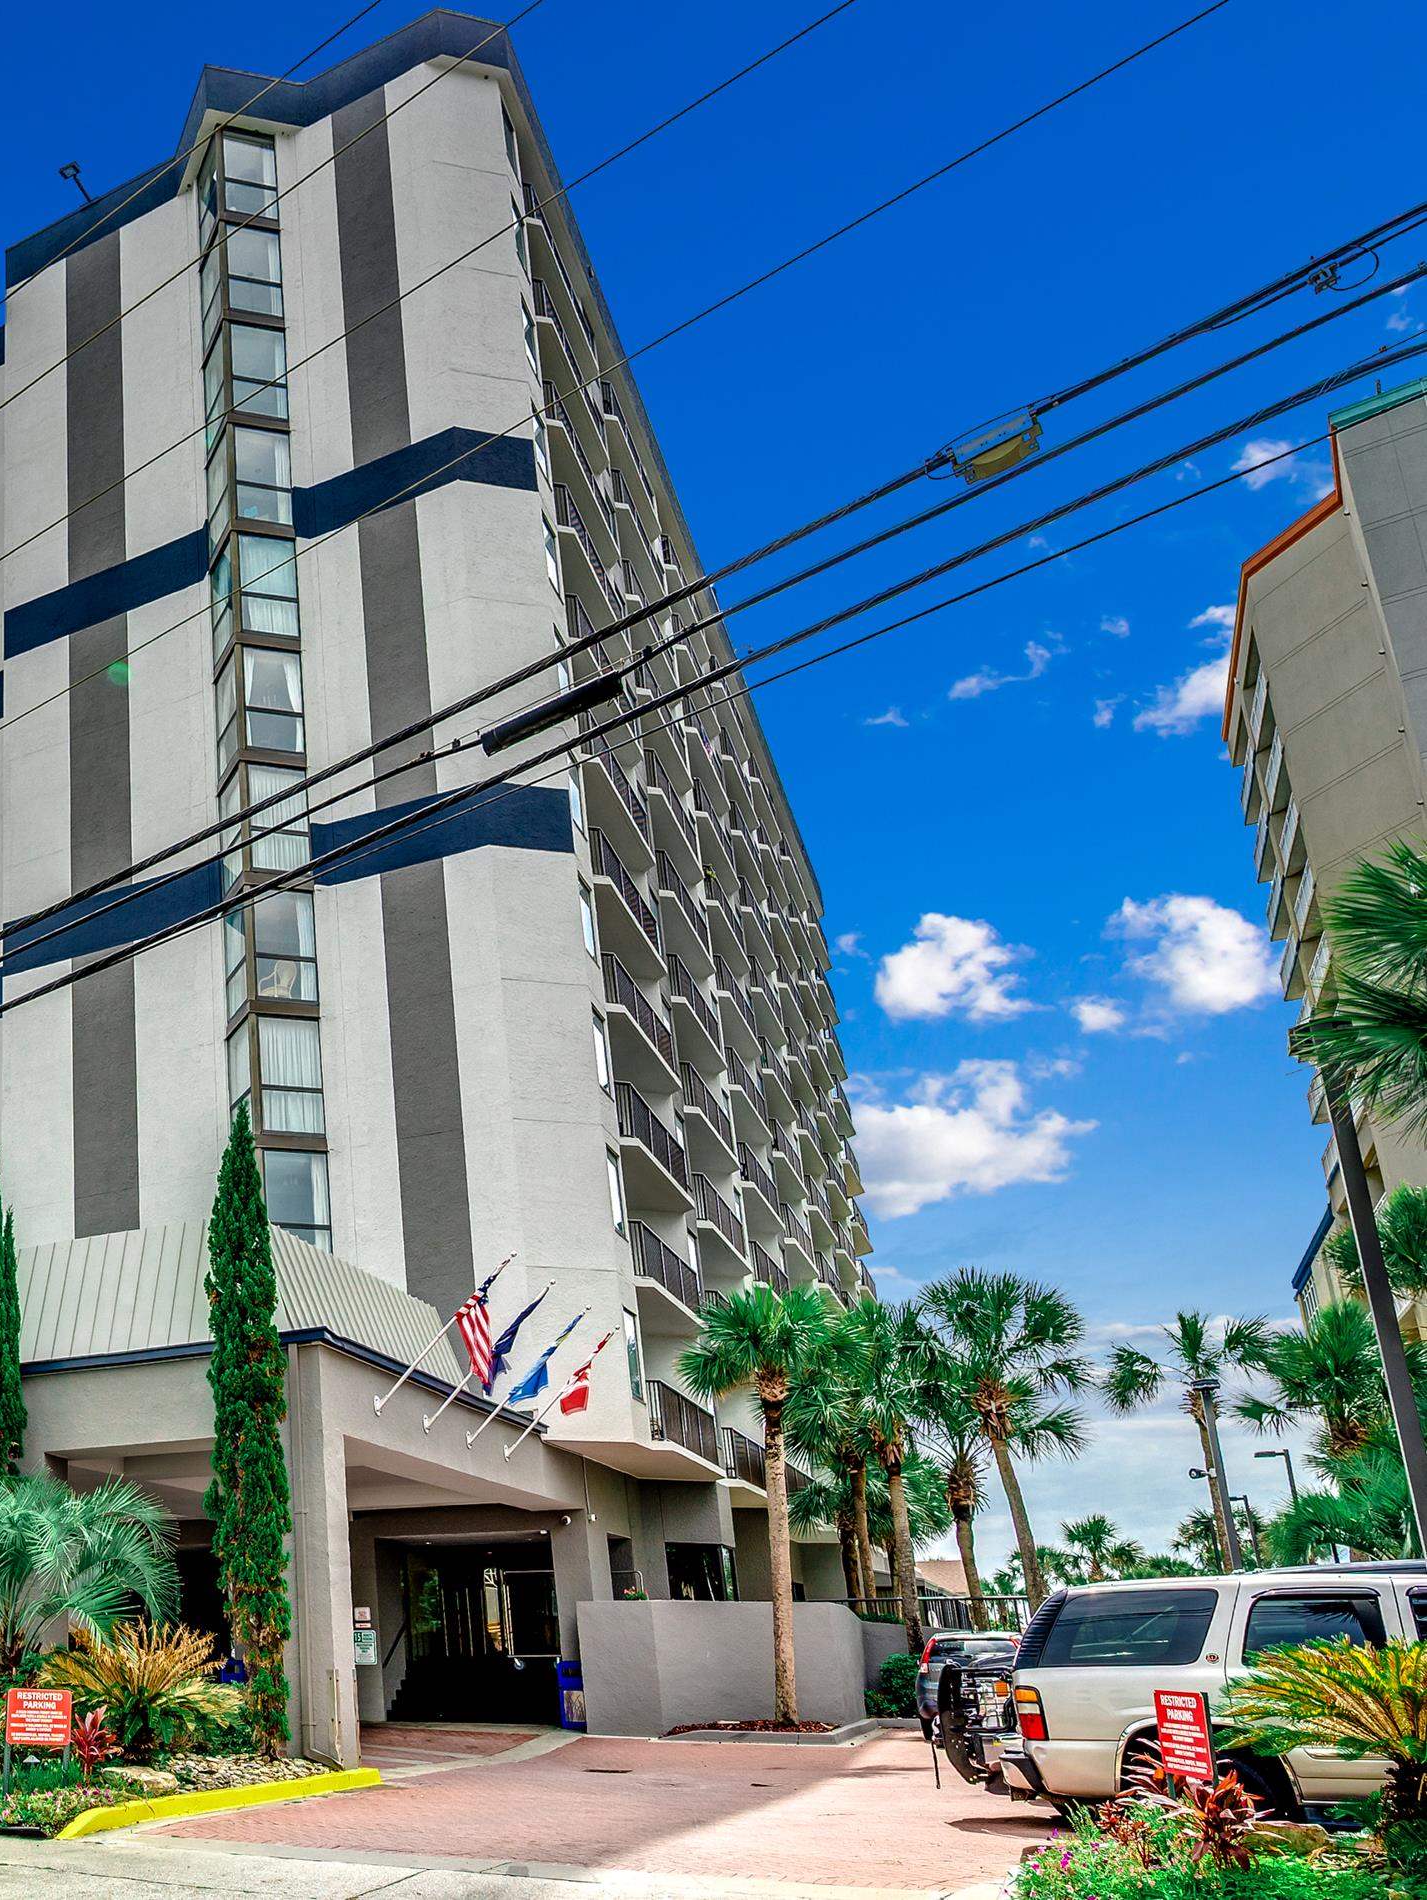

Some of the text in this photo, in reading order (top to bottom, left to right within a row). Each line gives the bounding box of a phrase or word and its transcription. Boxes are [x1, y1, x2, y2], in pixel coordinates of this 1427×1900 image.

[17, 1692, 63, 1700] RESTRICTED
[23, 1701, 57, 1709] PARKING
[1160, 1695, 1196, 1708] RESTRICTED
[1166, 1709, 1194, 1721] PARKING
